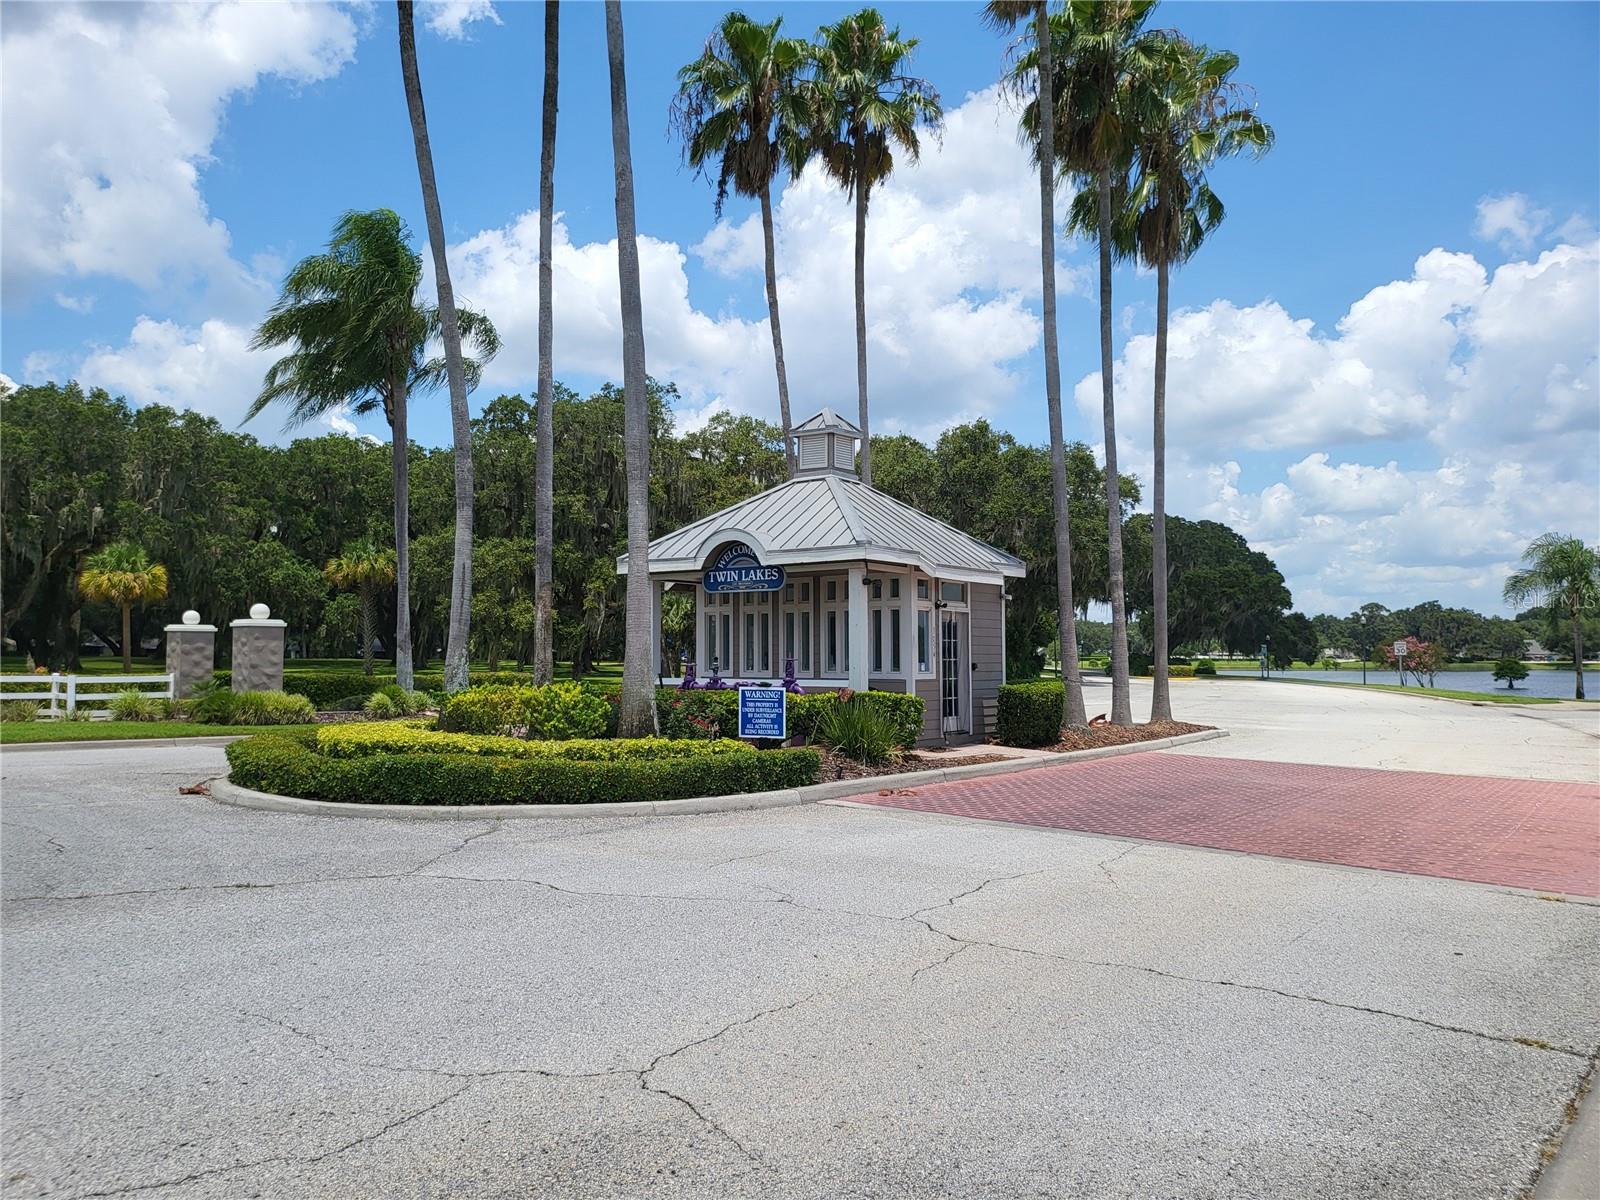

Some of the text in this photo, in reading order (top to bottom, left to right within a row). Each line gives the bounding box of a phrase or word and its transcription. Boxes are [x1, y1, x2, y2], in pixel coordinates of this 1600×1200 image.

[718, 544, 755, 569] WELCOME
[708, 568, 778, 582] TWIN LAKES
[744, 690, 780, 698] WARNING!
